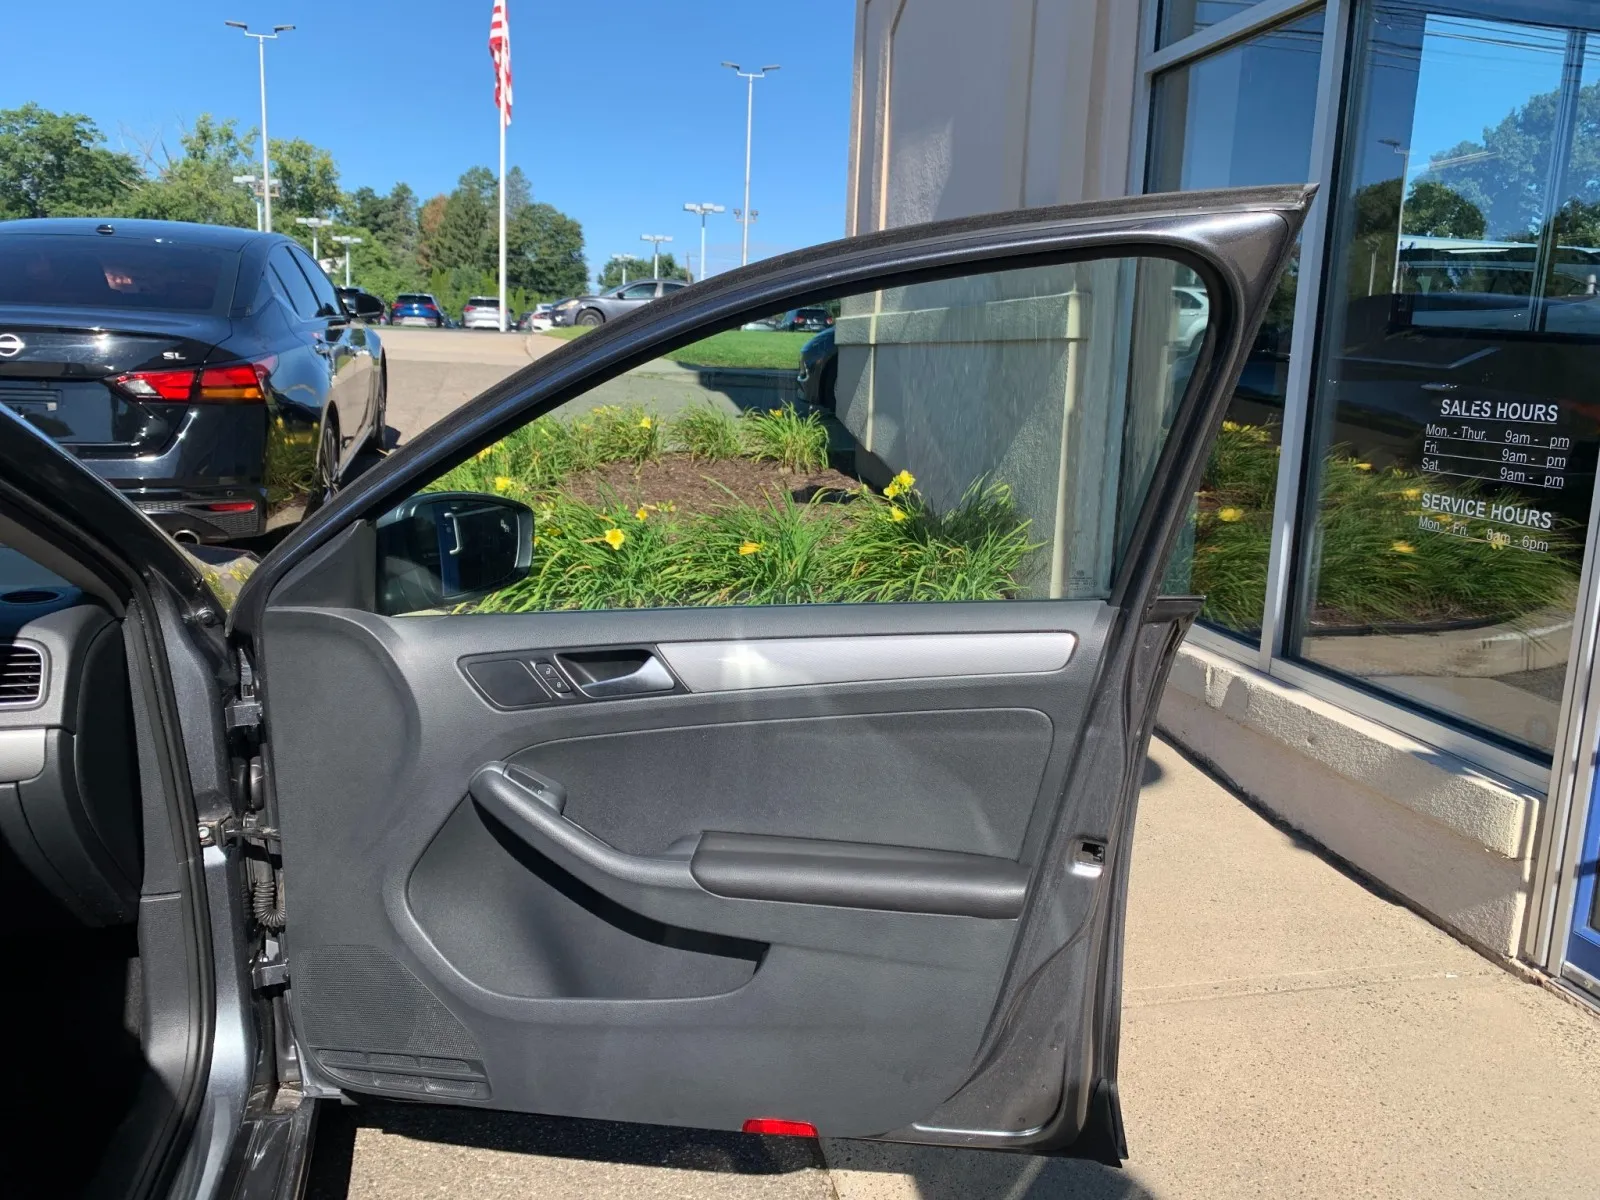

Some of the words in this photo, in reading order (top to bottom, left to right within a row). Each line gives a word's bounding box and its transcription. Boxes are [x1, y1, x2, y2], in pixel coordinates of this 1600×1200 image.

[163, 351, 186, 360] SL
[1440, 399, 1492, 417] SALES
[1496, 402, 1558, 421] HOURS
[1426, 424, 1450, 437] Mon.
[1462, 426, 1487, 440] Thur.
[1505, 430, 1530, 444] 9am
[1549, 436, 1570, 450] pm
[1424, 441, 1439, 454] Fri.
[1502, 449, 1527, 463] 9am
[1545, 456, 1566, 469] pm
[1421, 457, 1440, 471] Sat.
[1500, 467, 1525, 482] 9am
[1544, 475, 1564, 488] pm
[1421, 492, 1486, 518] SERVICE
[1491, 504, 1552, 529] HOURS
[1453, 522, 1469, 537] Fri.
[1486, 529, 1511, 545] 8am
[1522, 535, 1548, 552] 6pm
